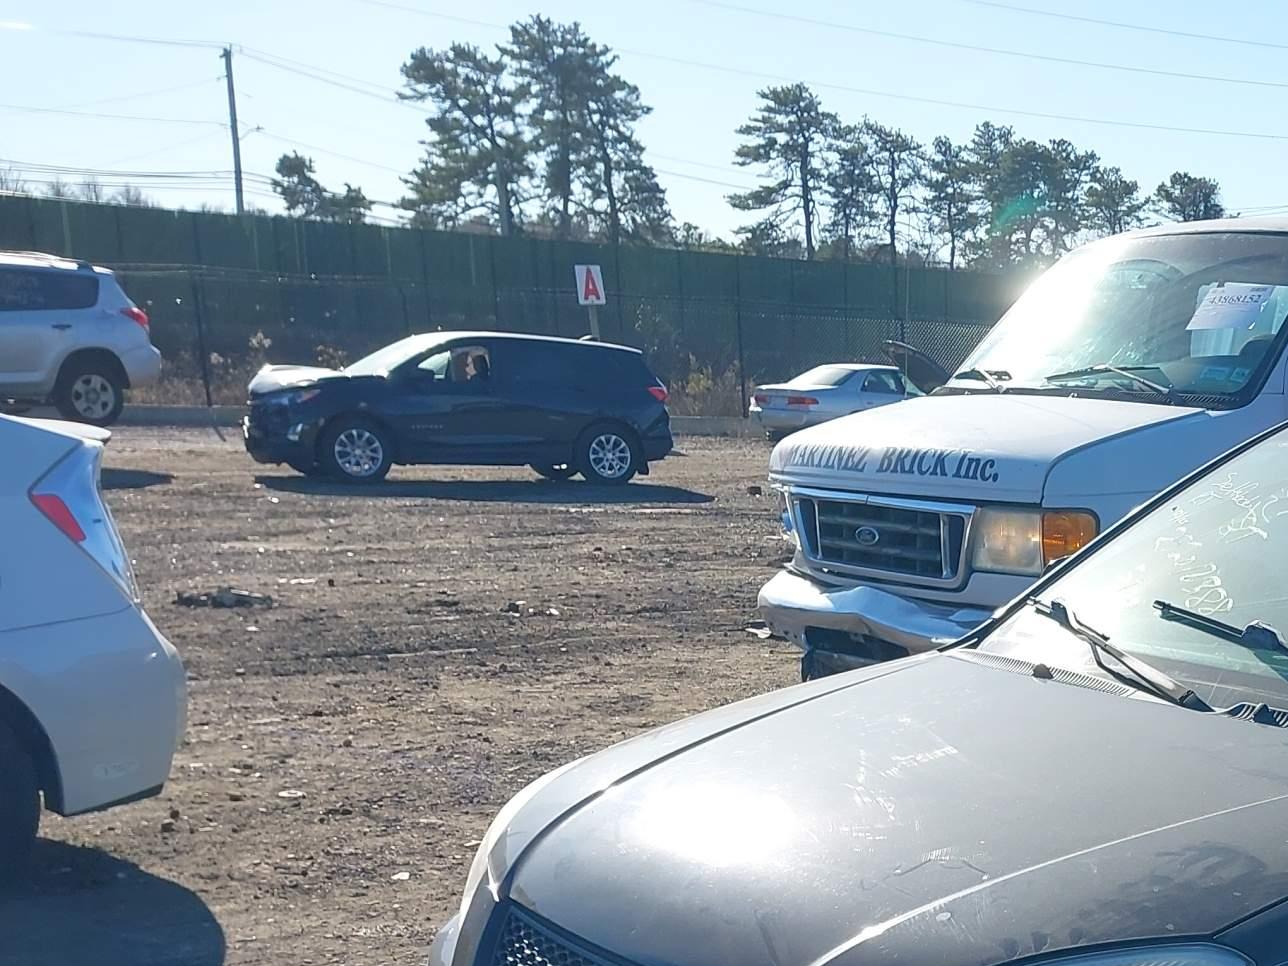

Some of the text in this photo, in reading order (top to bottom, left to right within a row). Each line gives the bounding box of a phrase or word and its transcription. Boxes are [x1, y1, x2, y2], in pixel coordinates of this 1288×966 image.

[583, 265, 601, 301] A
[784, 444, 1000, 483] MARTINEZ BRICK Inc.
